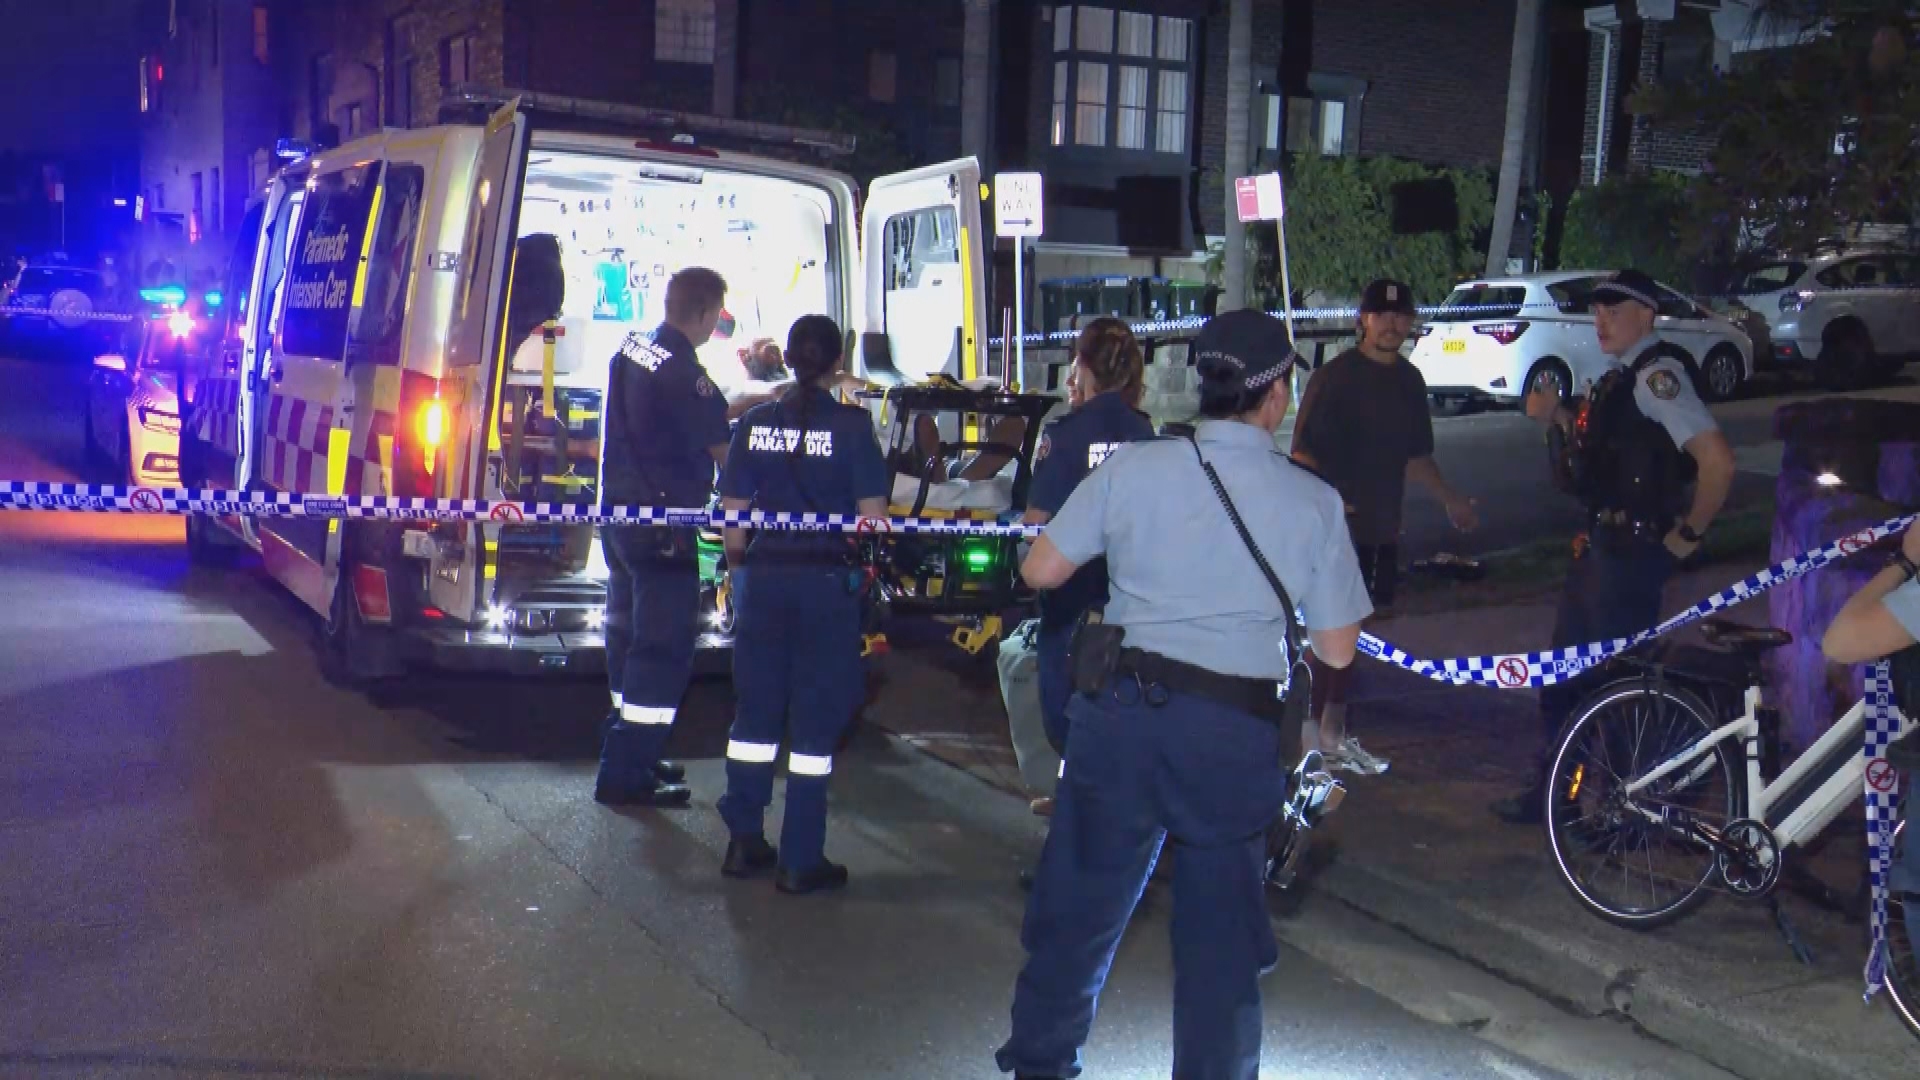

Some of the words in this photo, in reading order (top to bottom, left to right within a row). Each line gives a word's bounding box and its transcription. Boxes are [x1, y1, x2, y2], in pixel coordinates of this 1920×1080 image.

[302, 223, 349, 265] Paramedic
[288, 272, 325, 309] Intensive
[324, 268, 347, 309] Care
[748, 435, 833, 457] PARAMDIC
